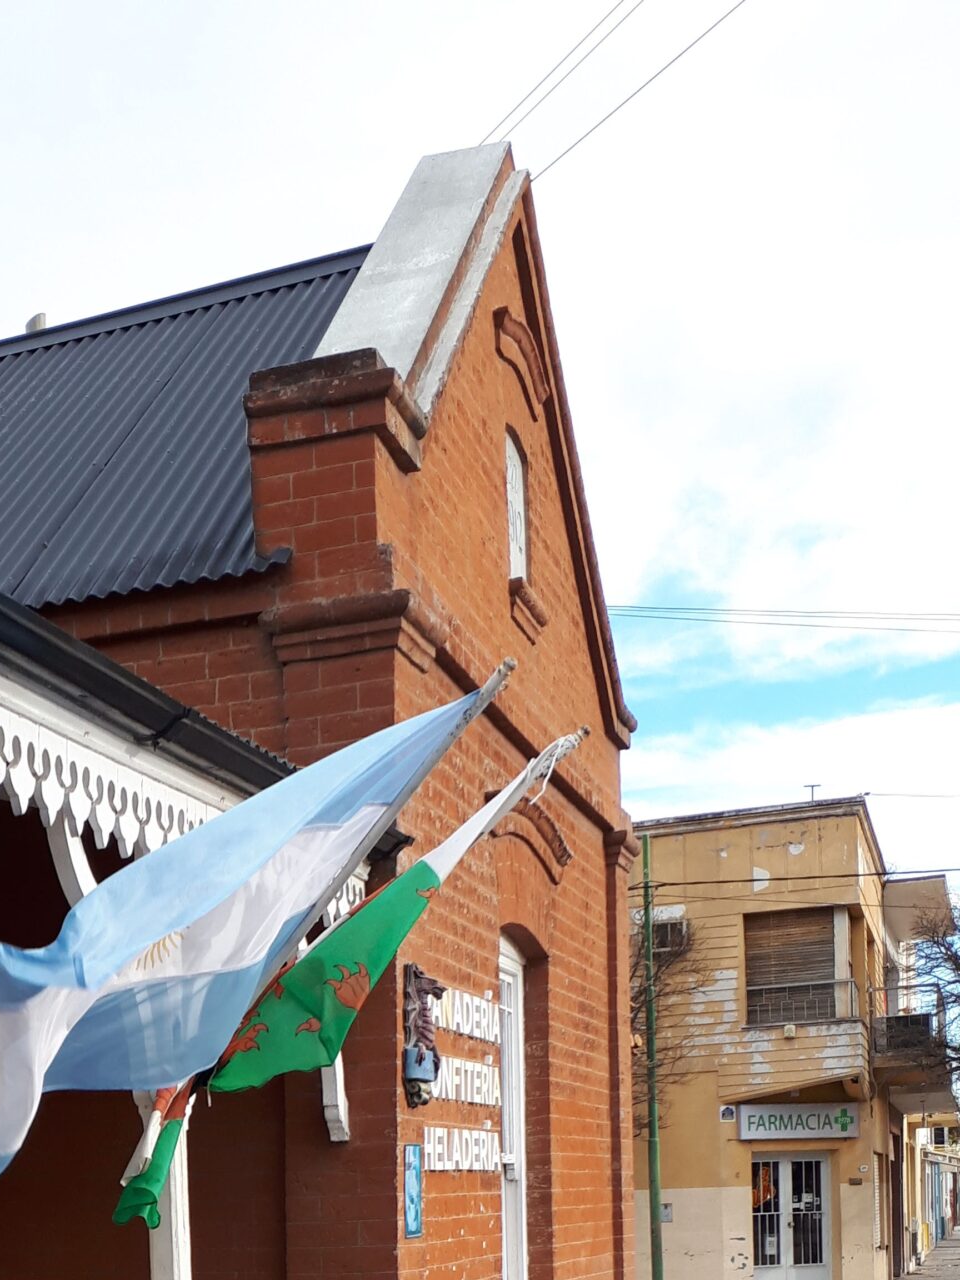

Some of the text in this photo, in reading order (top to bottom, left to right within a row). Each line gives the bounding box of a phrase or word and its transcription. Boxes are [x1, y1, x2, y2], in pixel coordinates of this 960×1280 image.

[431, 1055, 501, 1106] ONFITERÍA
[424, 1119, 501, 1171] HELADERÍA
[747, 1113, 833, 1132] FARMACIA
